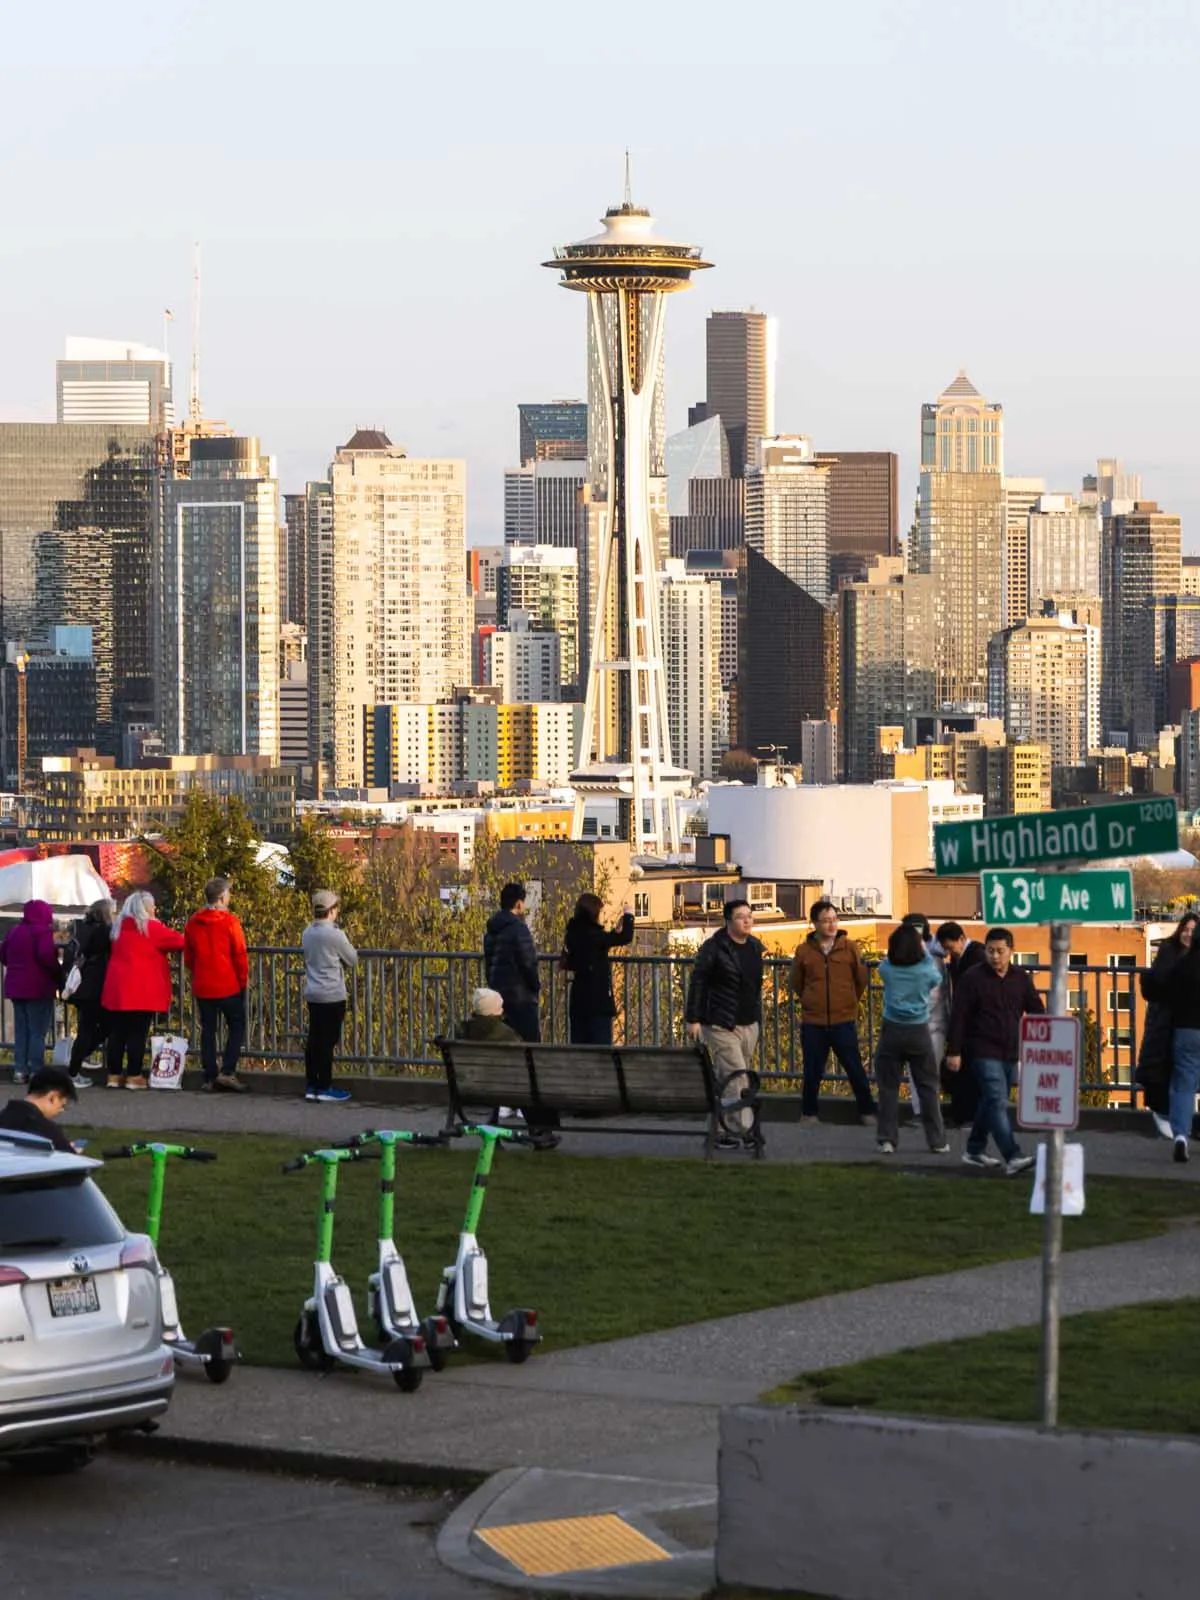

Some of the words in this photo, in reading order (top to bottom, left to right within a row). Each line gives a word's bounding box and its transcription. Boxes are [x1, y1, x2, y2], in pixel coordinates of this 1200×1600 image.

[1139, 801, 1173, 823] 1200
[940, 839, 959, 867] W
[970, 814, 1097, 866] Highland
[1108, 820, 1137, 848] Dr
[1011, 877, 1045, 919] 3rd
[1060, 884, 1090, 911] Ave
[1111, 882, 1125, 909] W
[1027, 1021, 1048, 1039] NO
[1026, 1048, 1073, 1066] PARKING
[1037, 1073, 1059, 1090] ANY
[1035, 1096, 1062, 1115] TIME
